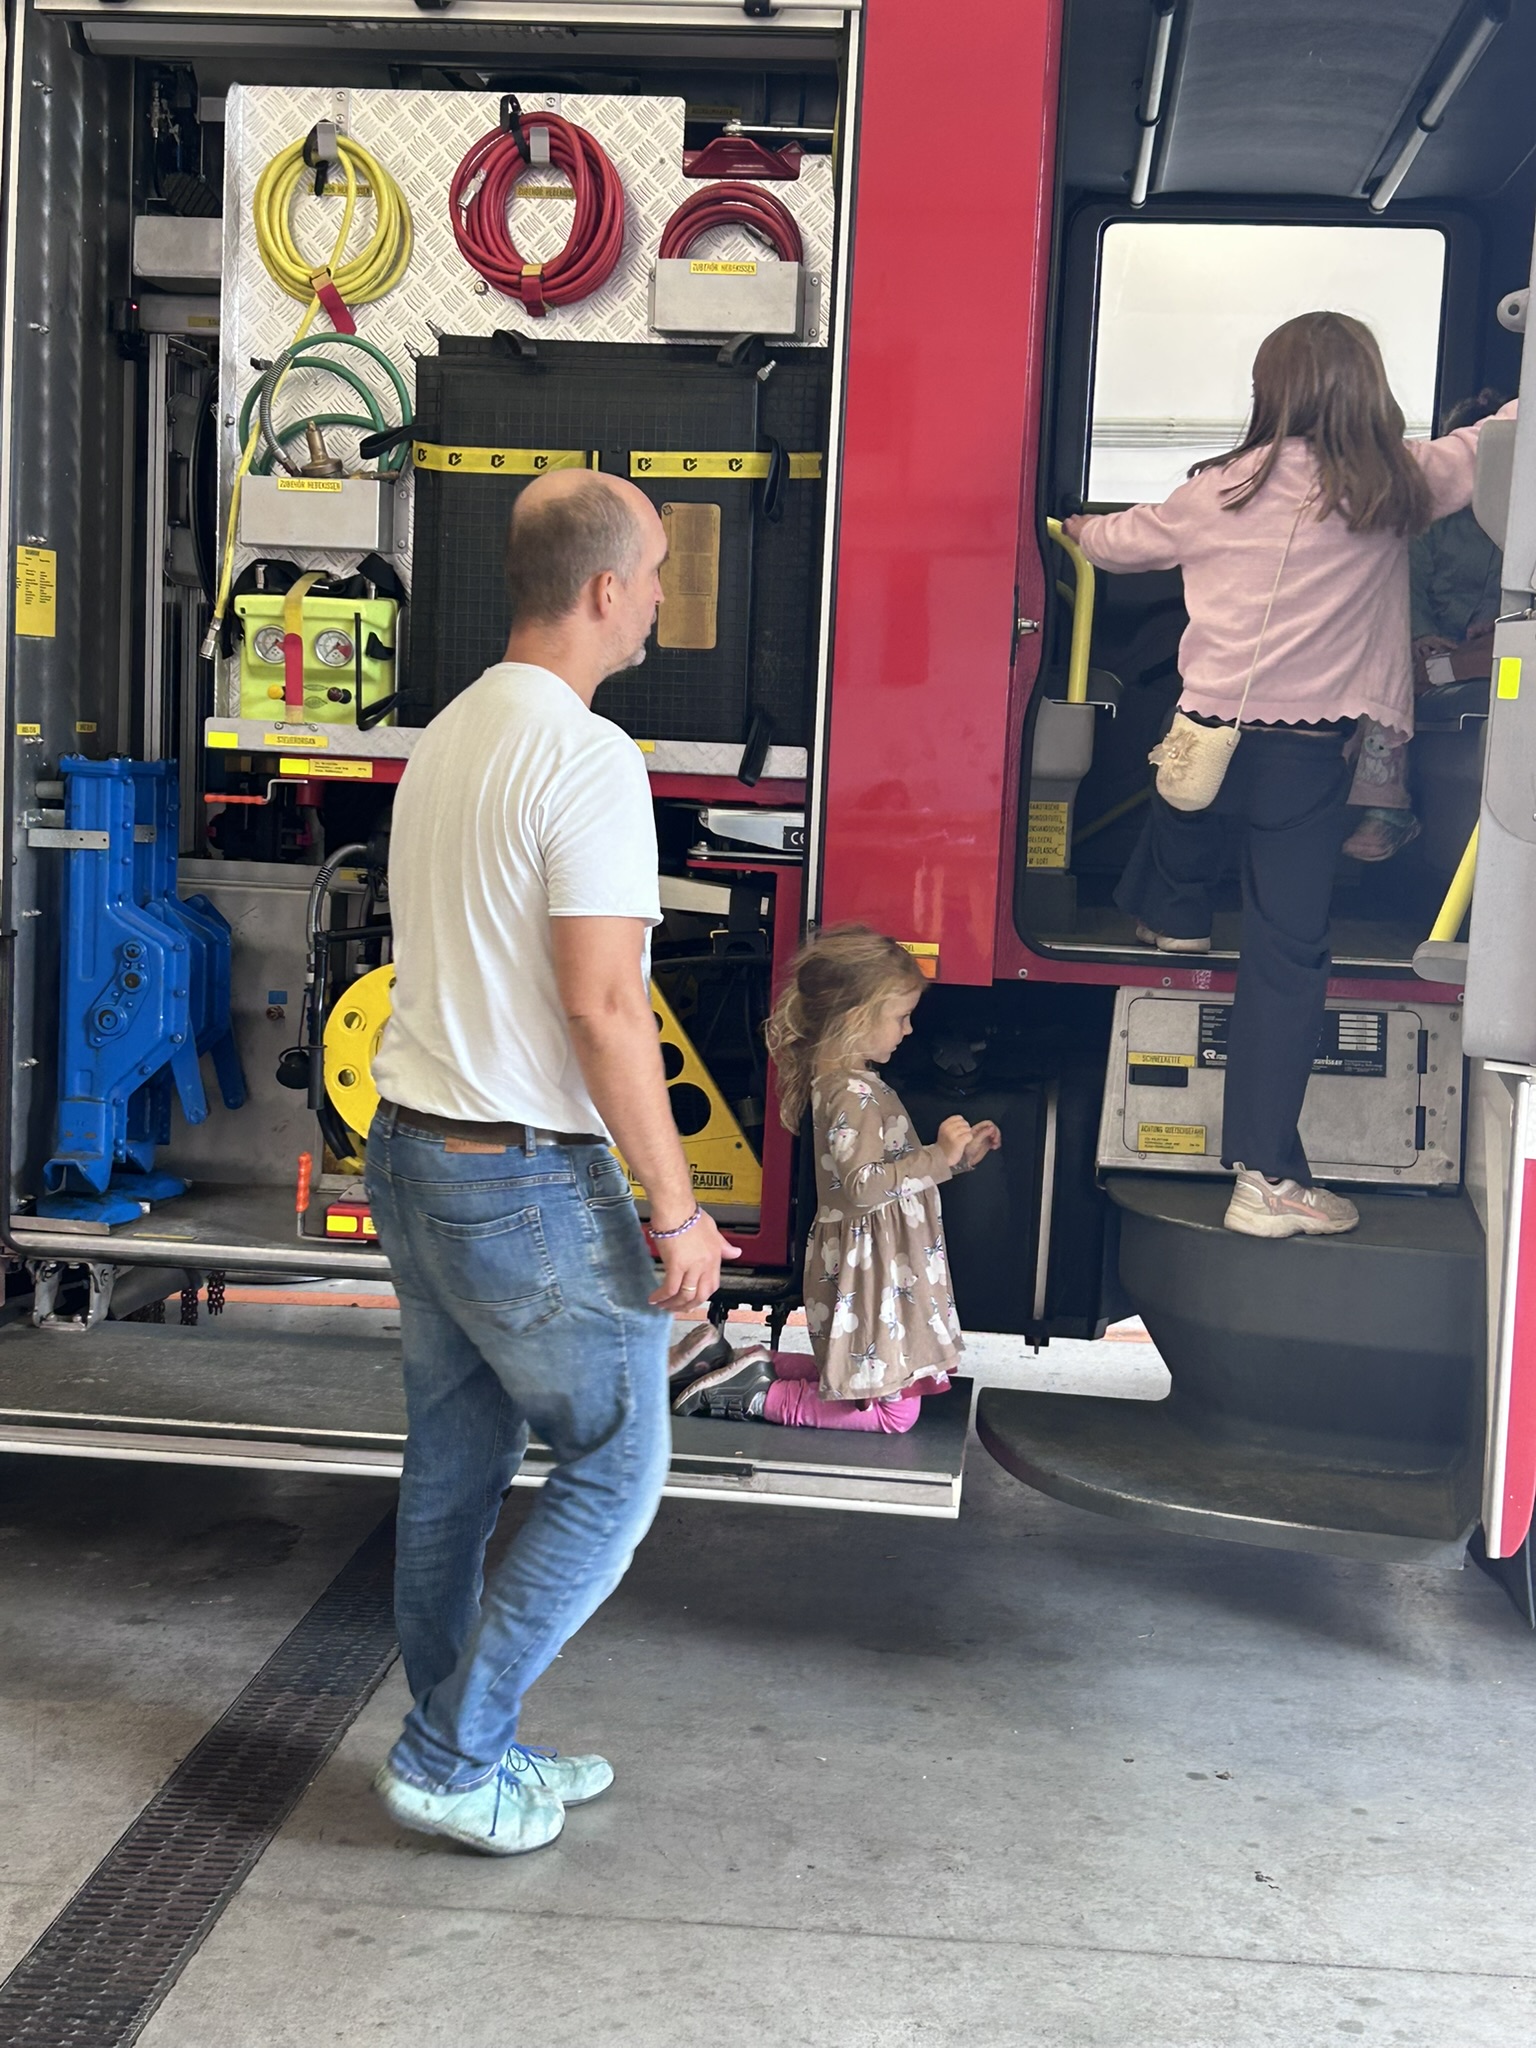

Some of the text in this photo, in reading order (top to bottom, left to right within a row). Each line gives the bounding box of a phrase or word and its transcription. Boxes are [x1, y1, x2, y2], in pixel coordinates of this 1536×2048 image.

[692, 262, 755, 273] ZUBEHÖR HEBEKISSEN
[279, 479, 306, 489] ZUBEHÖR
[1142, 1054, 1182, 1065] SCHNEEKETTE
[1140, 1124, 1164, 1134] ACHTUNG
[692, 1173, 731, 1187] RAULIK
